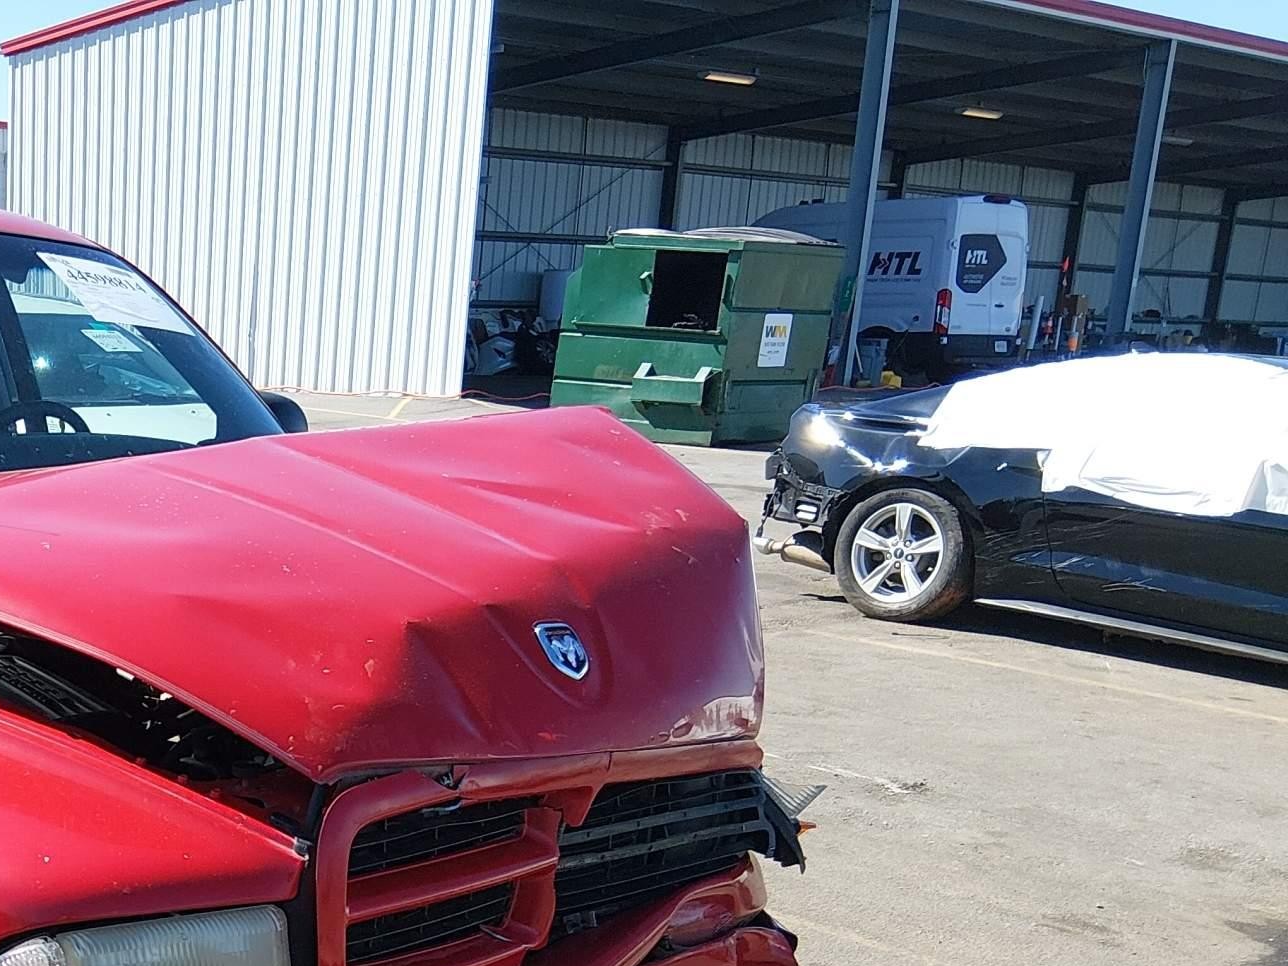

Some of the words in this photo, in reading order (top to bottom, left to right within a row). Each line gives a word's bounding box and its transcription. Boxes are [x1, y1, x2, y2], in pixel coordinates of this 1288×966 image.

[867, 251, 923, 276] HTL
[964, 249, 989, 266] HTL
[66, 268, 147, 294] 44598814
[765, 325, 788, 339] WM
